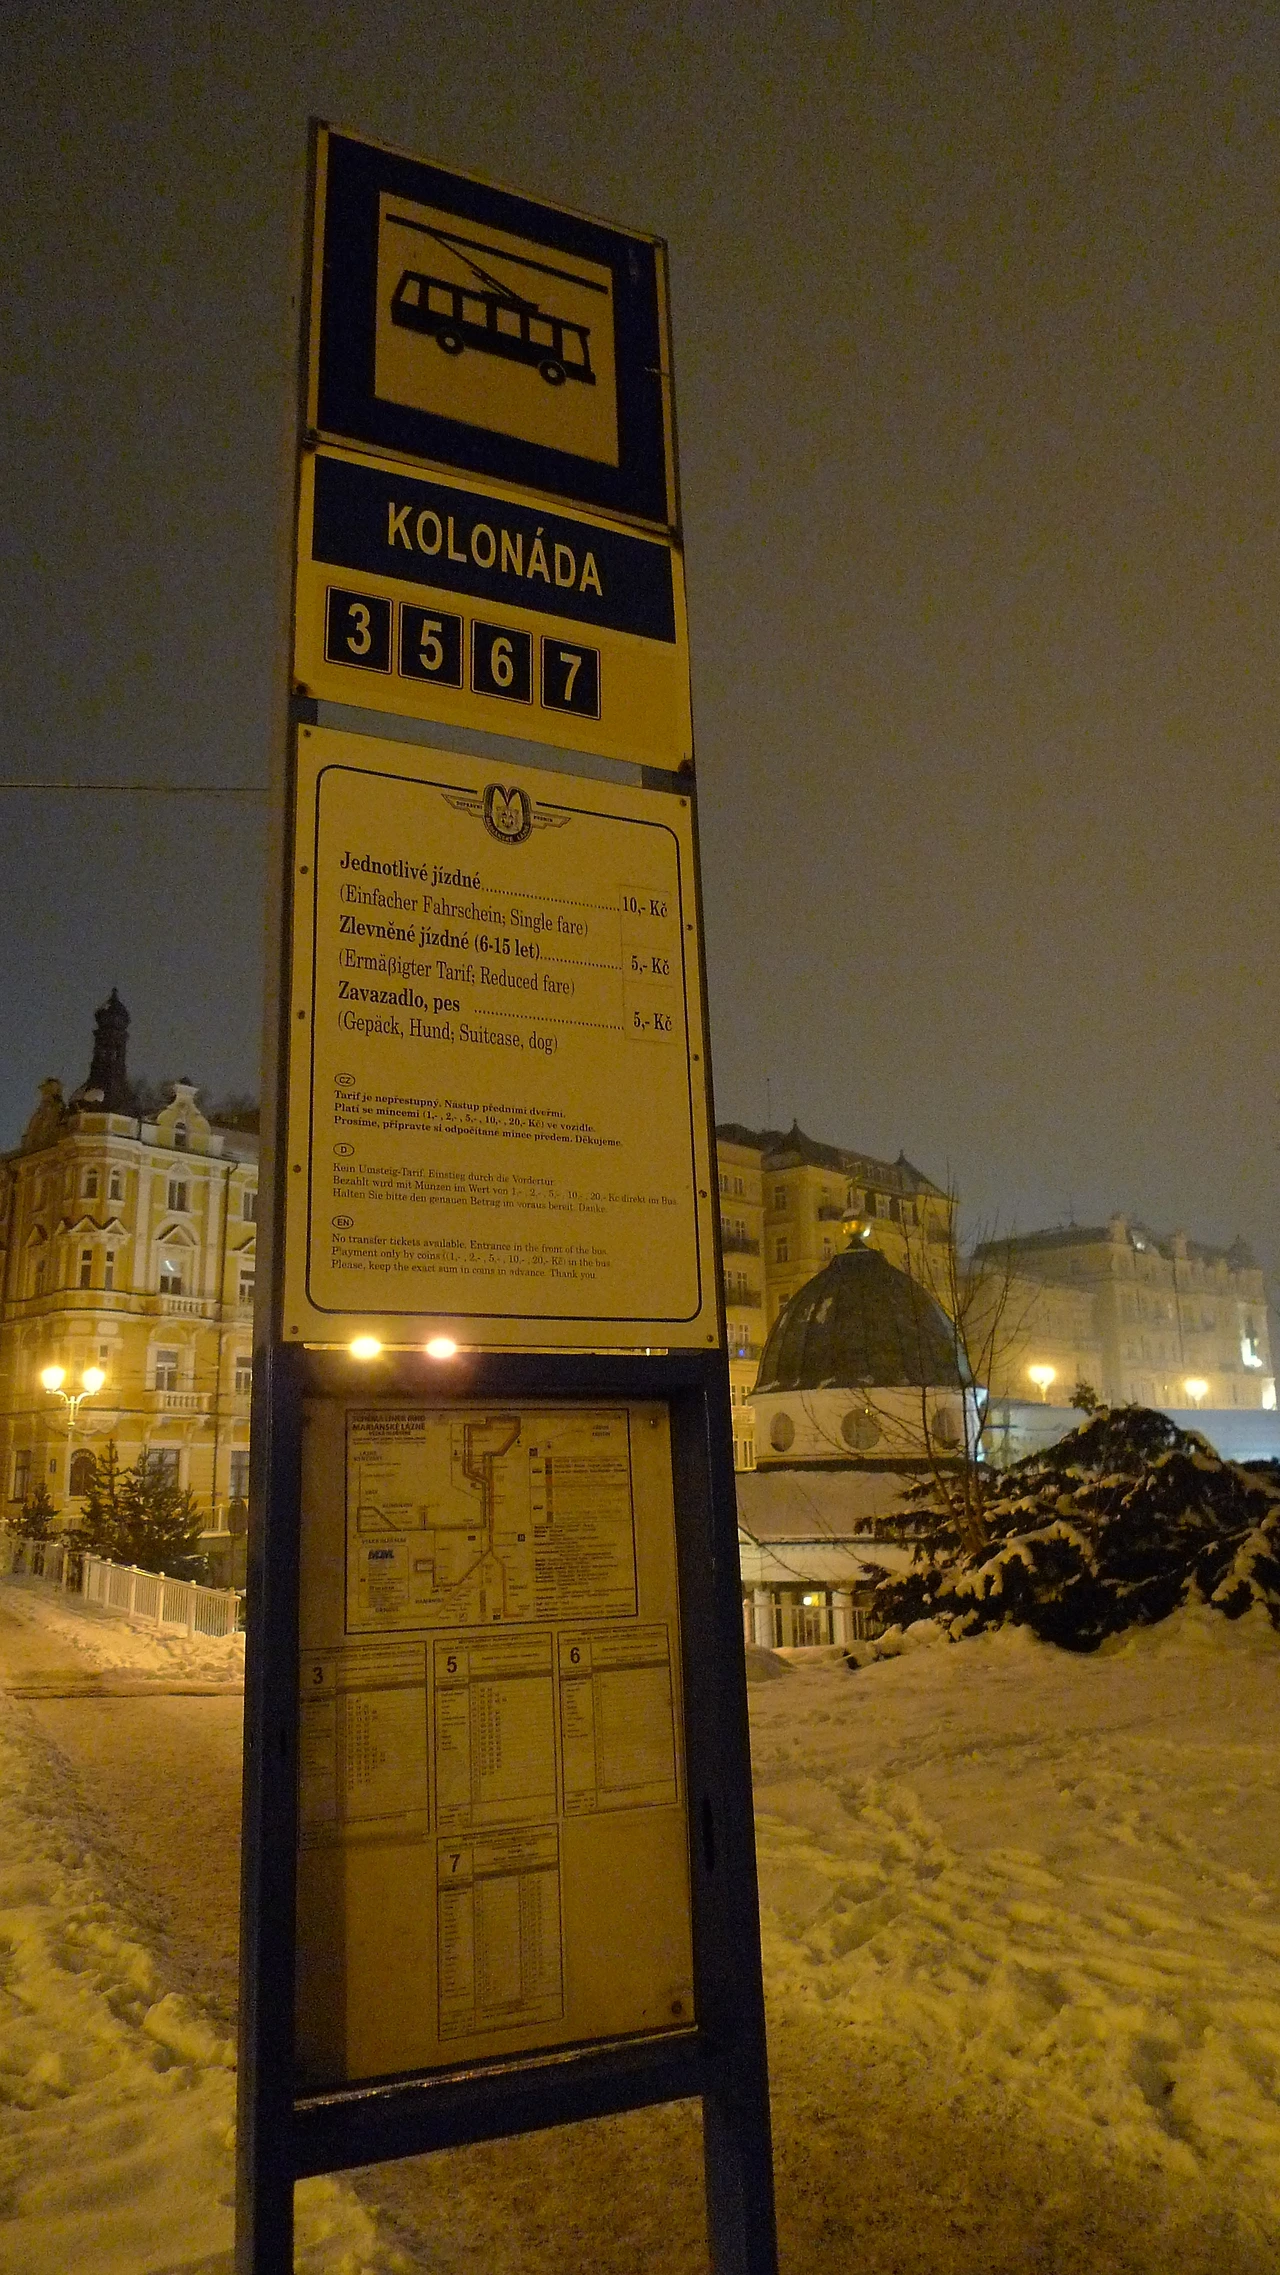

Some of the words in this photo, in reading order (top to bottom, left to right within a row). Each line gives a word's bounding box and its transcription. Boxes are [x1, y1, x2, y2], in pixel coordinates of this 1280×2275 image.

[388, 502, 603, 596] KOLONÁDA
[346, 603, 371, 655] 3
[419, 619, 443, 671] 5
[491, 637, 514, 687] 6
[559, 651, 582, 701] 7
[340, 851, 428, 881] Jednotlivé
[430, 866, 480, 889] jízdné
[650, 900, 667, 917] Kč
[339, 884, 418, 911] (Einfacher
[421, 895, 505, 925] Fahrschein;
[510, 909, 552, 933] Single
[557, 916, 588, 936] fare)
[339, 915, 415, 942] Zlevněné
[419, 926, 469, 949] jízdné
[474, 935, 510, 954] (6-15
[515, 939, 540, 960] let)
[651, 957, 669, 975] Kč
[339, 949, 431, 979] (Ermäßigter
[436, 961, 474, 983] Tarif;
[480, 966, 538, 990] Reduced
[543, 975, 575, 995] fare)
[338, 981, 427, 1012] Zavazadlo,
[432, 998, 459, 1014] pes
[653, 1013, 672, 1031] Kč
[338, 1011, 403, 1038] (Gepäck,
[409, 1018, 454, 1043] Hund;
[459, 1024, 523, 1049] Suitcase,
[528, 1031, 558, 1055] dog)
[313, 1667, 324, 1685] 3
[446, 1656, 458, 1673] 5
[570, 1647, 580, 1663] 6
[449, 1854, 461, 1873] 7
